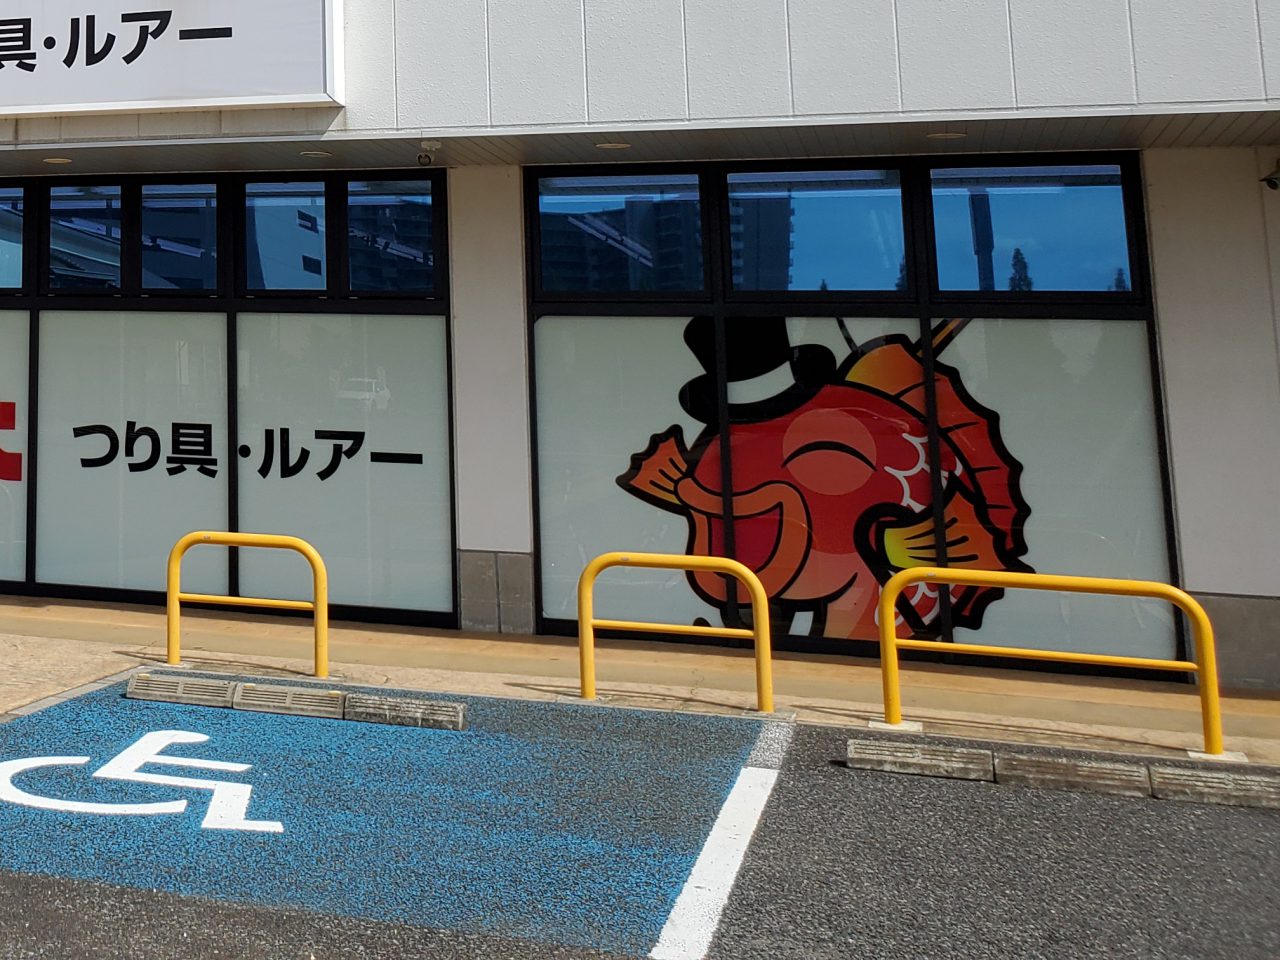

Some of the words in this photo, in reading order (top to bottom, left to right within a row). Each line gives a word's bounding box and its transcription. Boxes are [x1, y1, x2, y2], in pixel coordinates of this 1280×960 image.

[72, 420, 424, 482] つり具・ルアー
